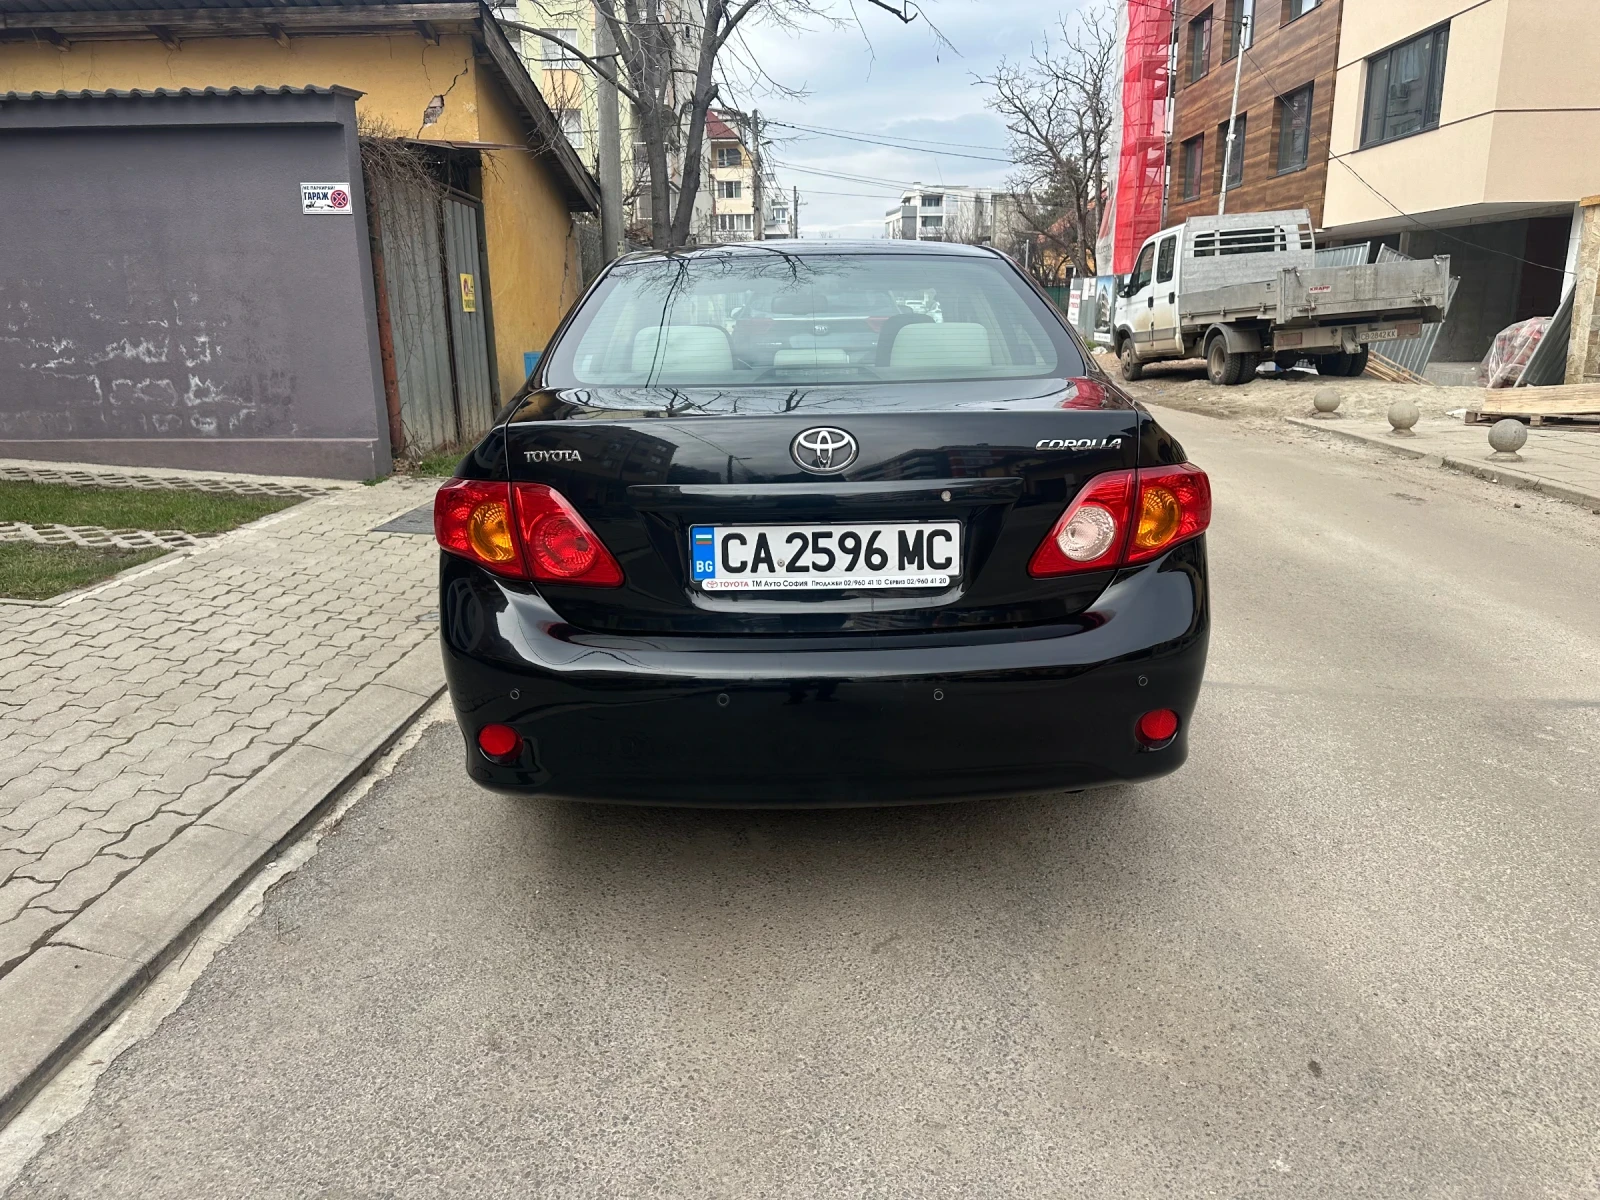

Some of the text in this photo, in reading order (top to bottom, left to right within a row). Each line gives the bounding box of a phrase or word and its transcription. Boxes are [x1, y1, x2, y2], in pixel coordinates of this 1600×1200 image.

[303, 192, 329, 200] ГАРАЖ
[1035, 438, 1122, 451] COROLLA
[523, 450, 582, 462] TOYOTA
[721, 529, 953, 573] CA 2596 MC
[696, 560, 713, 572] BG
[782, 580, 808, 588] София
